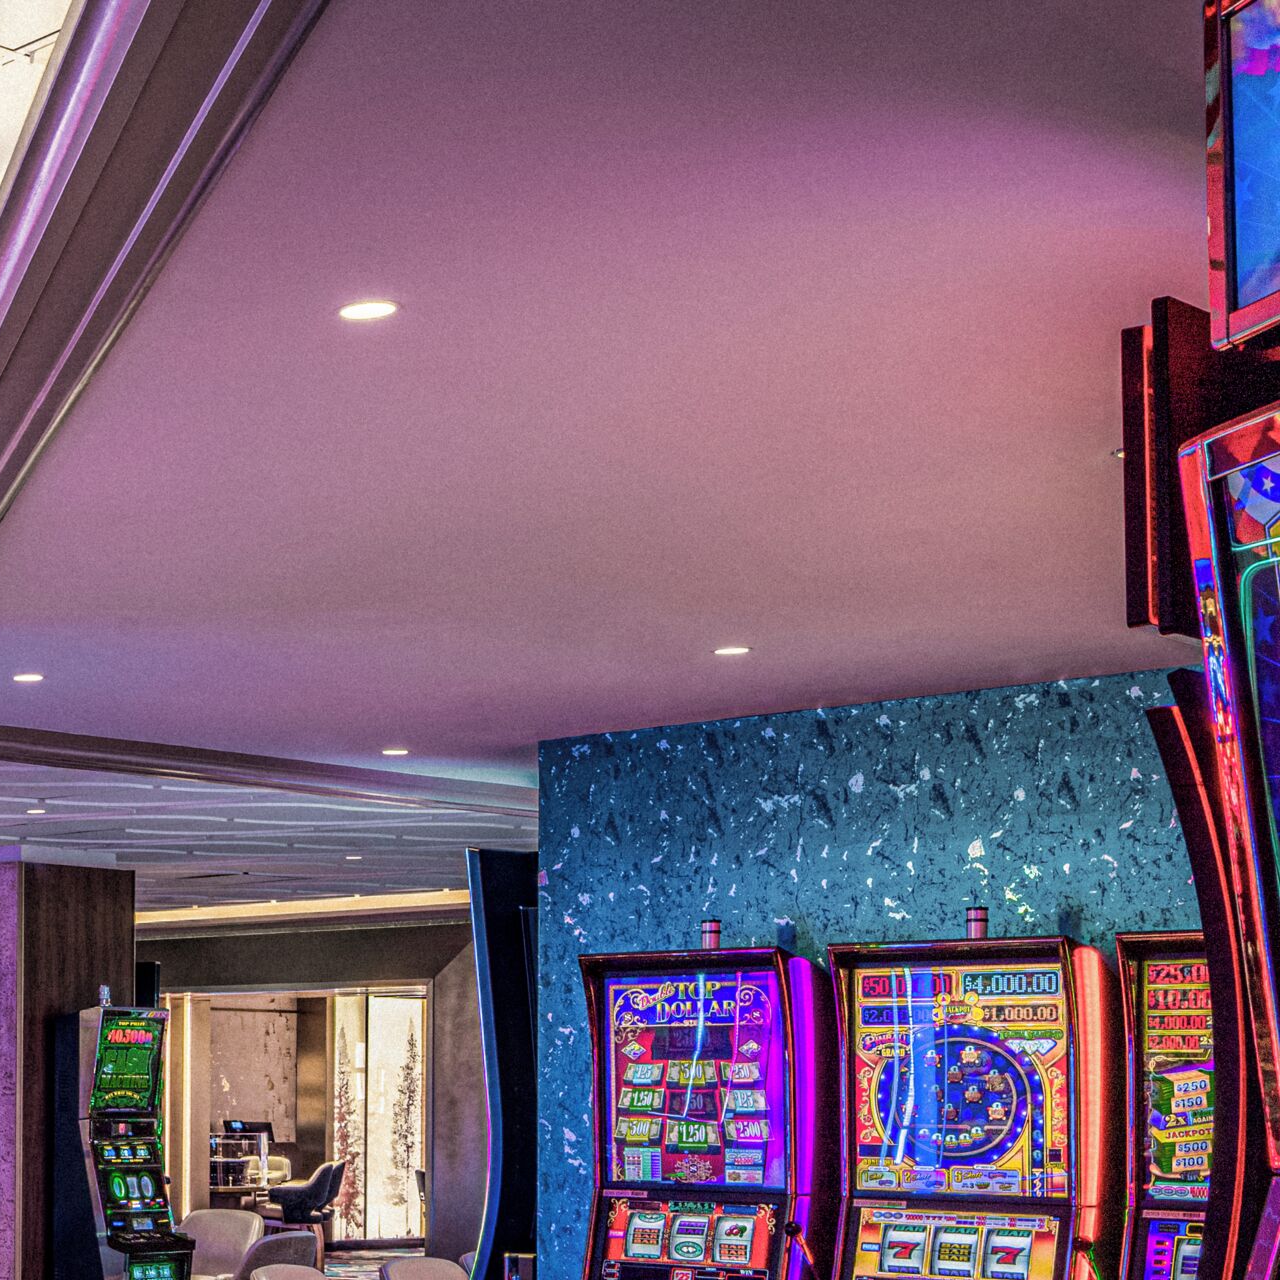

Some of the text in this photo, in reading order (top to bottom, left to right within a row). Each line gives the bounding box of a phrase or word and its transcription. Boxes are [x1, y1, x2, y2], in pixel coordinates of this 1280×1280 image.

[639, 982, 675, 1010] Double
[674, 981, 721, 1000] TOP
[656, 1001, 736, 1024] DOLLAR
[1149, 1016, 1206, 1029] $4,000.00
[881, 1049, 905, 1057] GRAND
[1176, 1080, 1207, 1092] $250
[1175, 1096, 1202, 1108] $150
[1165, 1128, 1211, 1139] JACKPOT
[1178, 1142, 1207, 1152] $500
[1175, 1157, 1203, 1166] $100
[888, 1241, 921, 1260] 7
[991, 1246, 1025, 1265] 7
